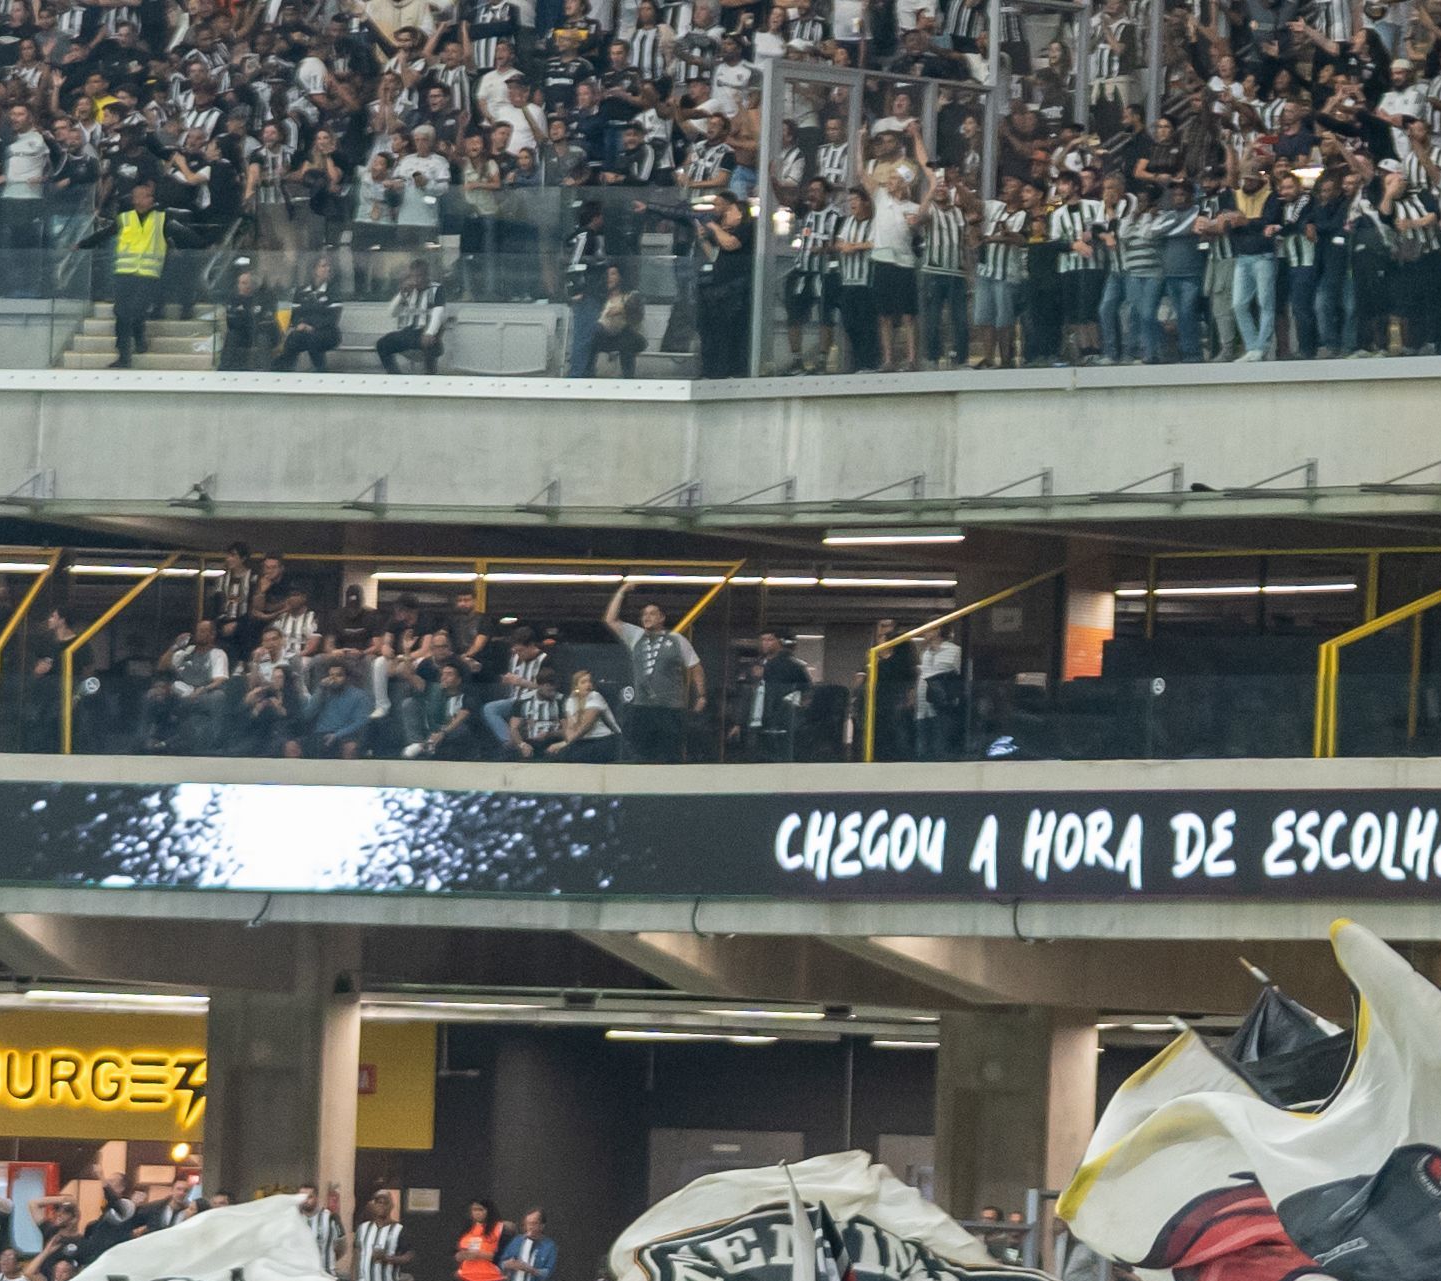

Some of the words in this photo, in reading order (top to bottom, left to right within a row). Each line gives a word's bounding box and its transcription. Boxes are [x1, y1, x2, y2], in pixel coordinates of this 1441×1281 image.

[775, 809, 946, 880] CHEGOU
[969, 814, 999, 889] A
[1022, 809, 1142, 889] HORA
[1170, 810, 1237, 878] DE
